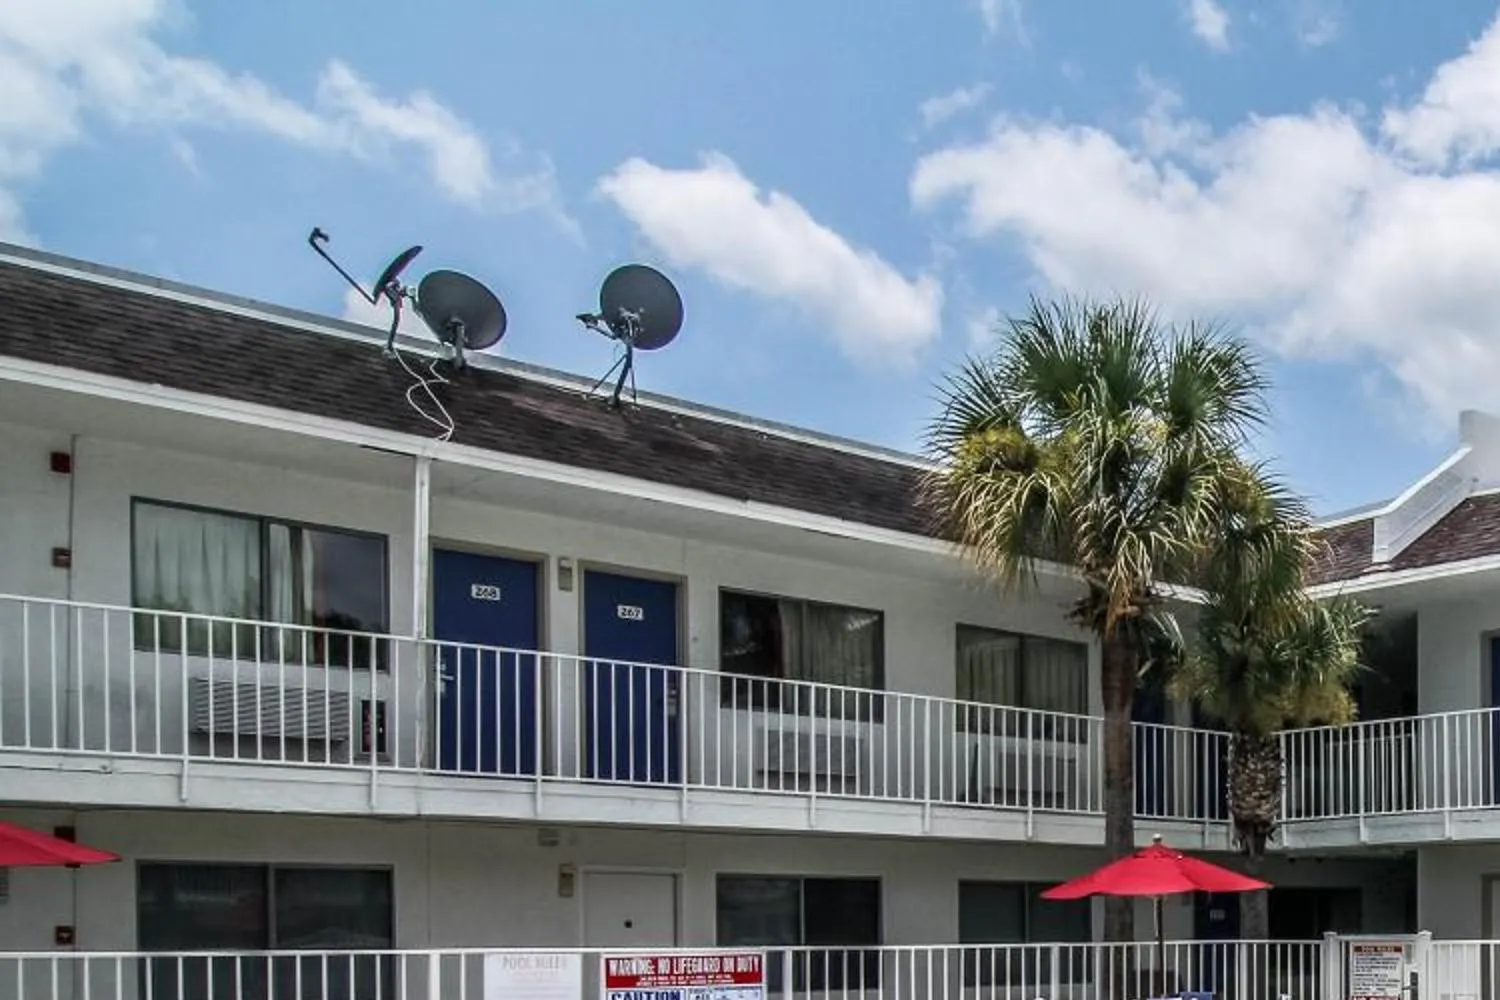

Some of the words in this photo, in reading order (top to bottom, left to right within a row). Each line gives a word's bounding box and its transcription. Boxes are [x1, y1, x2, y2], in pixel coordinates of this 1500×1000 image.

[658, 958, 671, 974] NO
[673, 957, 720, 974] LIFEGUARD
[722, 956, 735, 973] ON
[737, 955, 759, 972] DUTY
